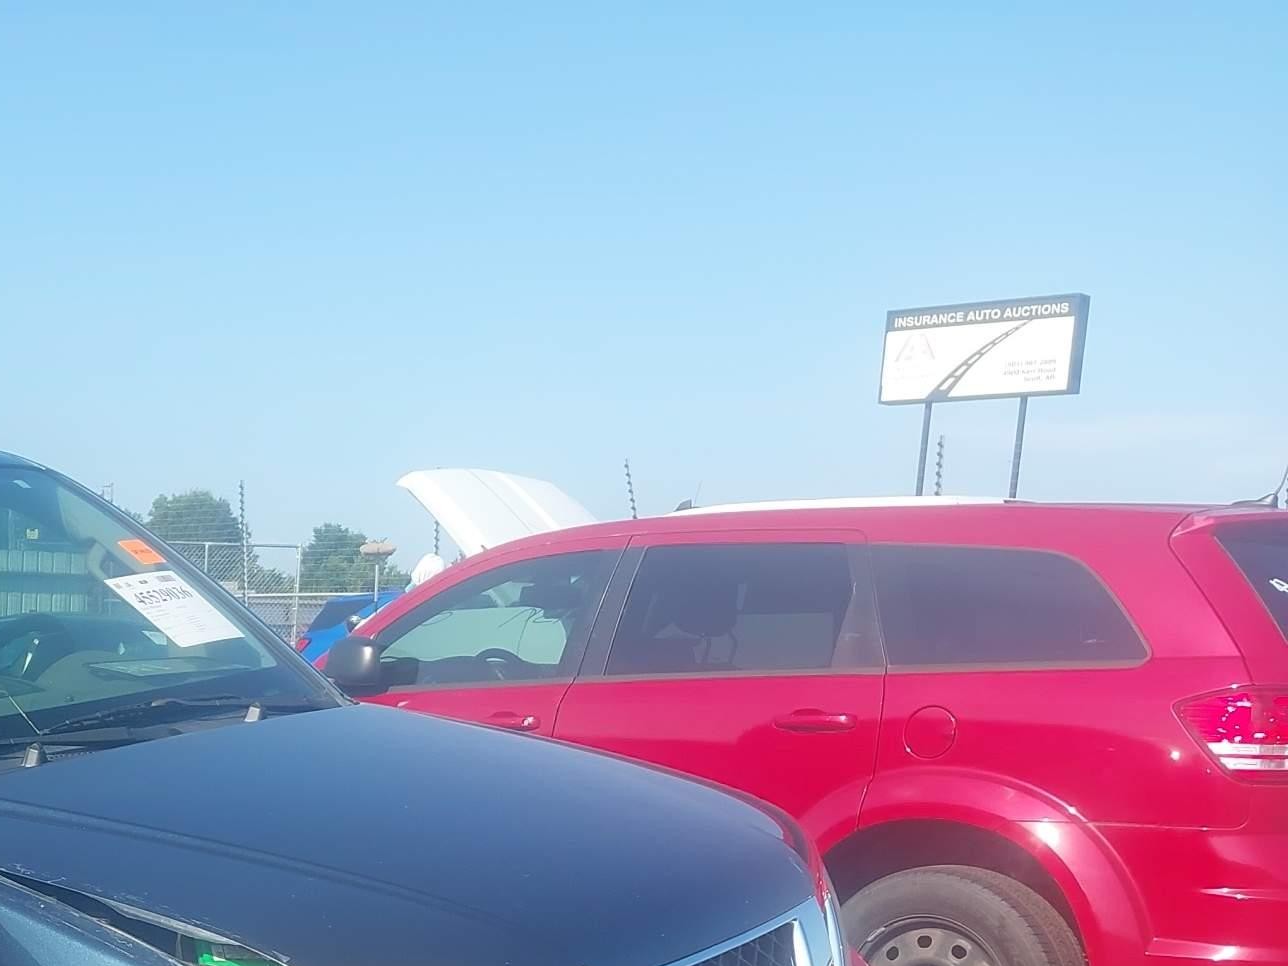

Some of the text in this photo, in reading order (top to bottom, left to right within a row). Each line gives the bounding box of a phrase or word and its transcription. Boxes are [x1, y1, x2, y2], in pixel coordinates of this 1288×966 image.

[894, 302, 1070, 328] INSURANCE AUTO AUCTIONS
[133, 585, 194, 606] 45529036
